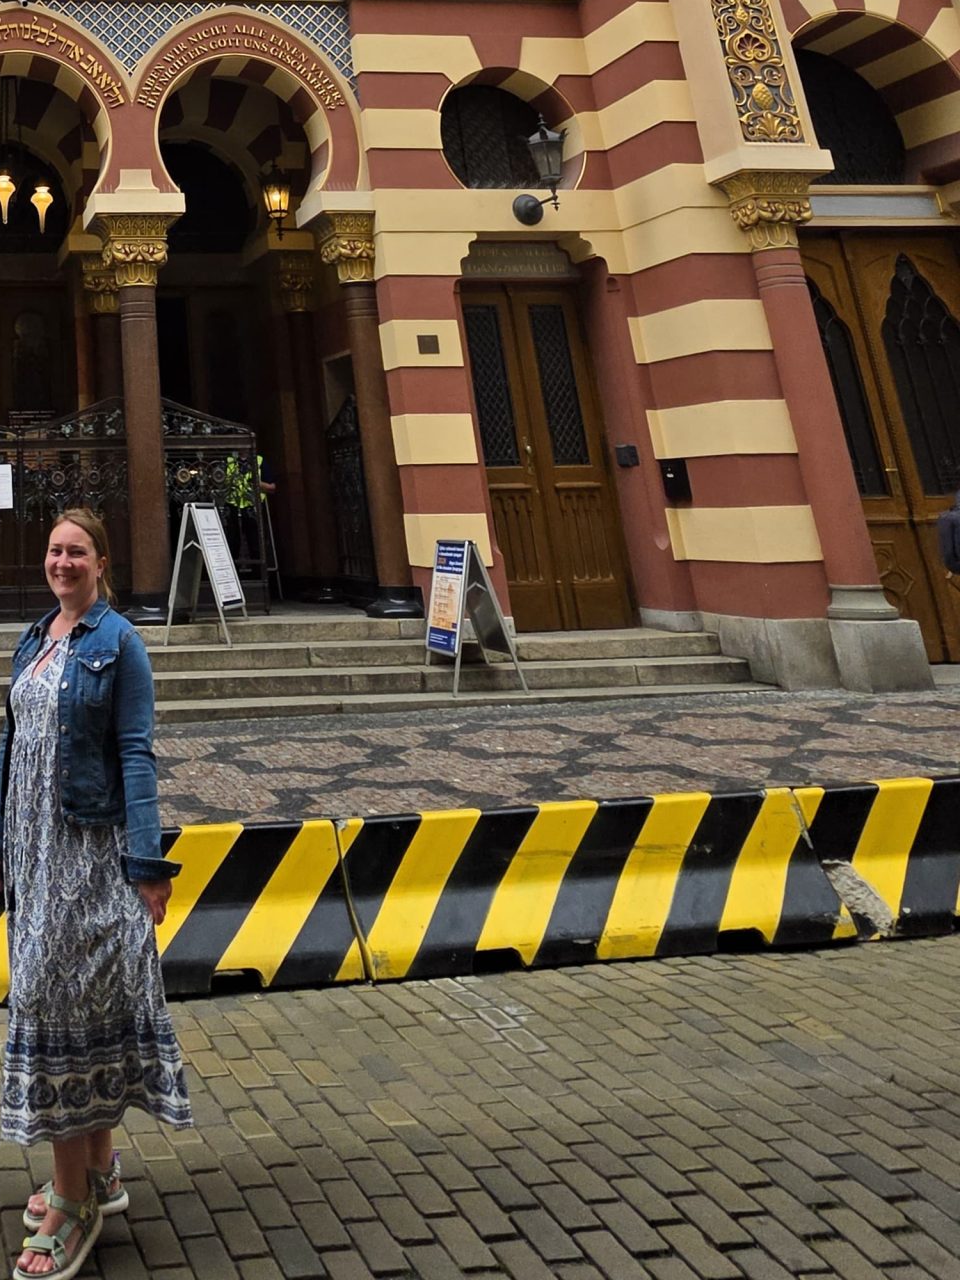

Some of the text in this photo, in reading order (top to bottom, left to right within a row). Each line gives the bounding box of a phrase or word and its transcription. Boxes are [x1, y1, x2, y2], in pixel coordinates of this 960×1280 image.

[137, 63, 165, 104] HABEN
[163, 42, 188, 62] WIR
[187, 25, 228, 44] NICHT
[233, 24, 267, 38] ALLE
[269, 34, 308, 62] EINEN
[146, 38, 336, 110] HAT NICHT EIN GOTT UNS GESCHAFFEN?
